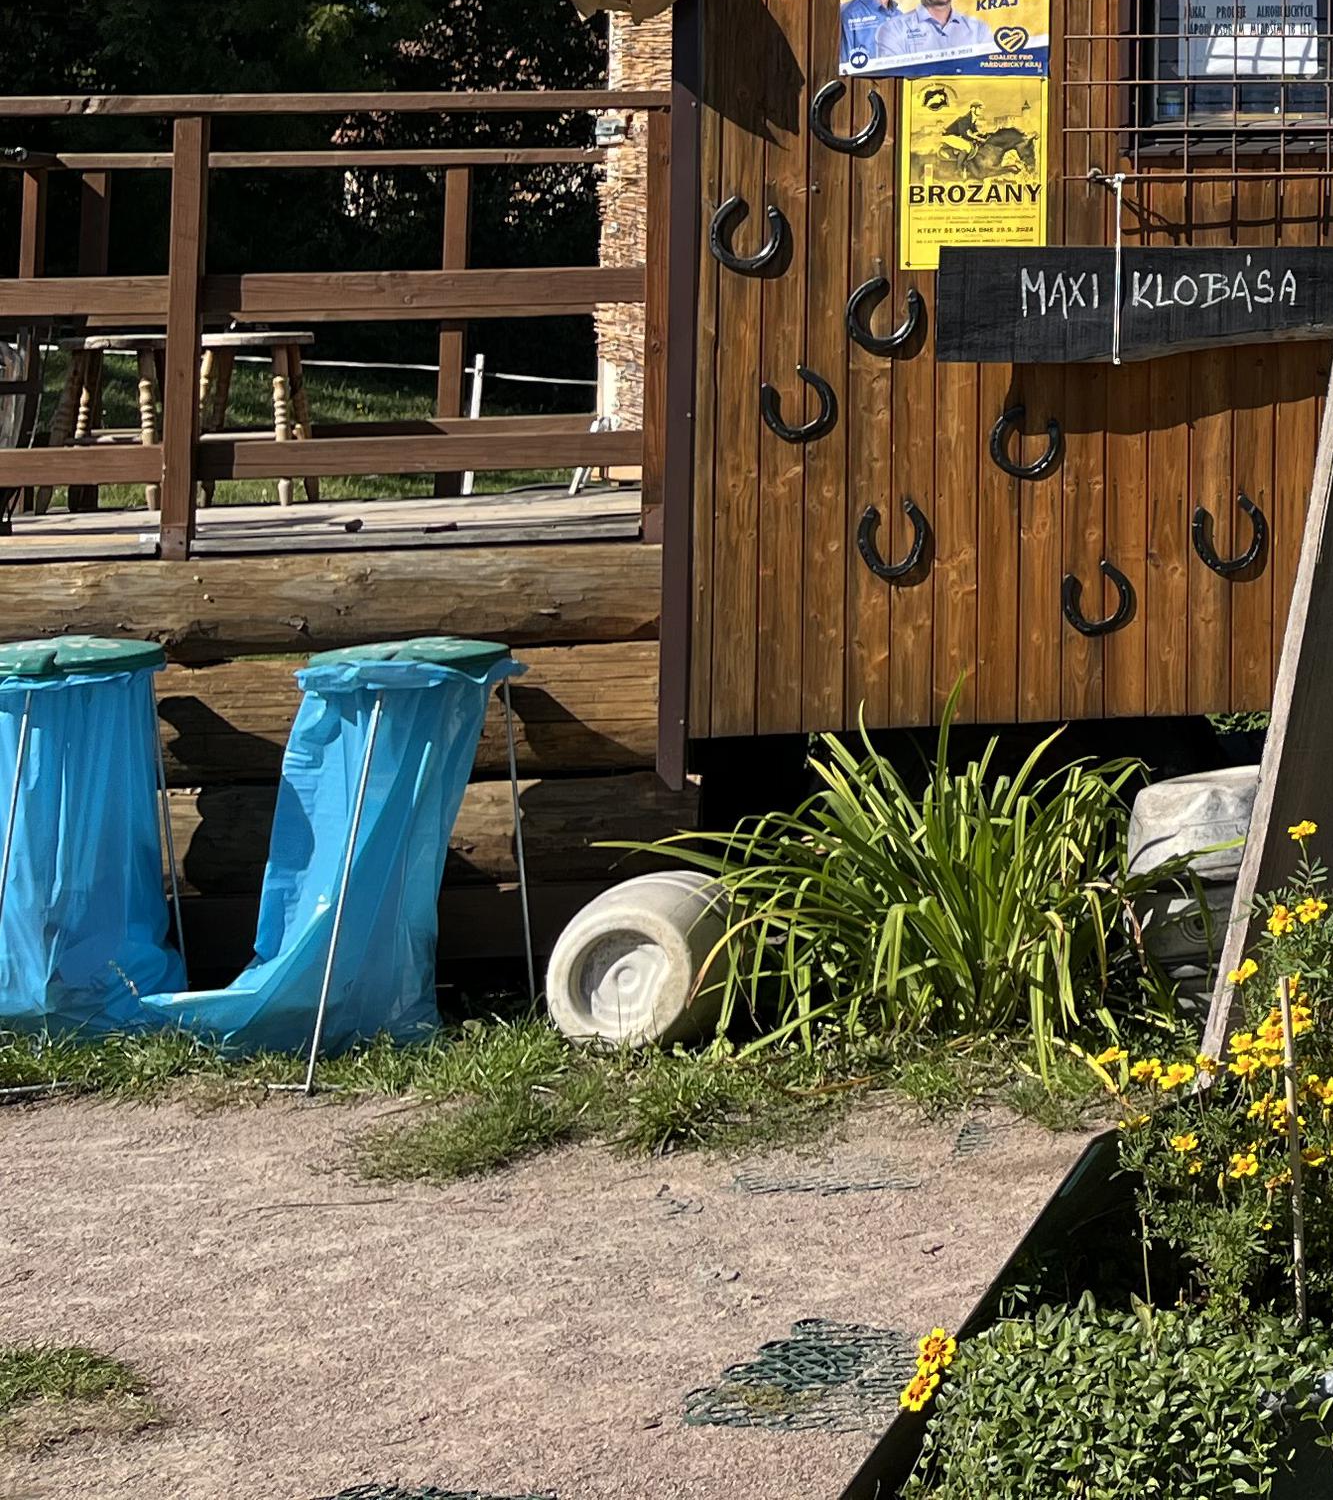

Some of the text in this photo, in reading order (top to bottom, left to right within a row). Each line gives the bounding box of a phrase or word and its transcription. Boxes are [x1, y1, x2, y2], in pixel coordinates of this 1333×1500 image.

[1256, 2, 1314, 18] ALKOHLICKÝCH
[909, 183, 1042, 204] BROZANY
[1021, 253, 1298, 319] MAXI KLOBÁSA
